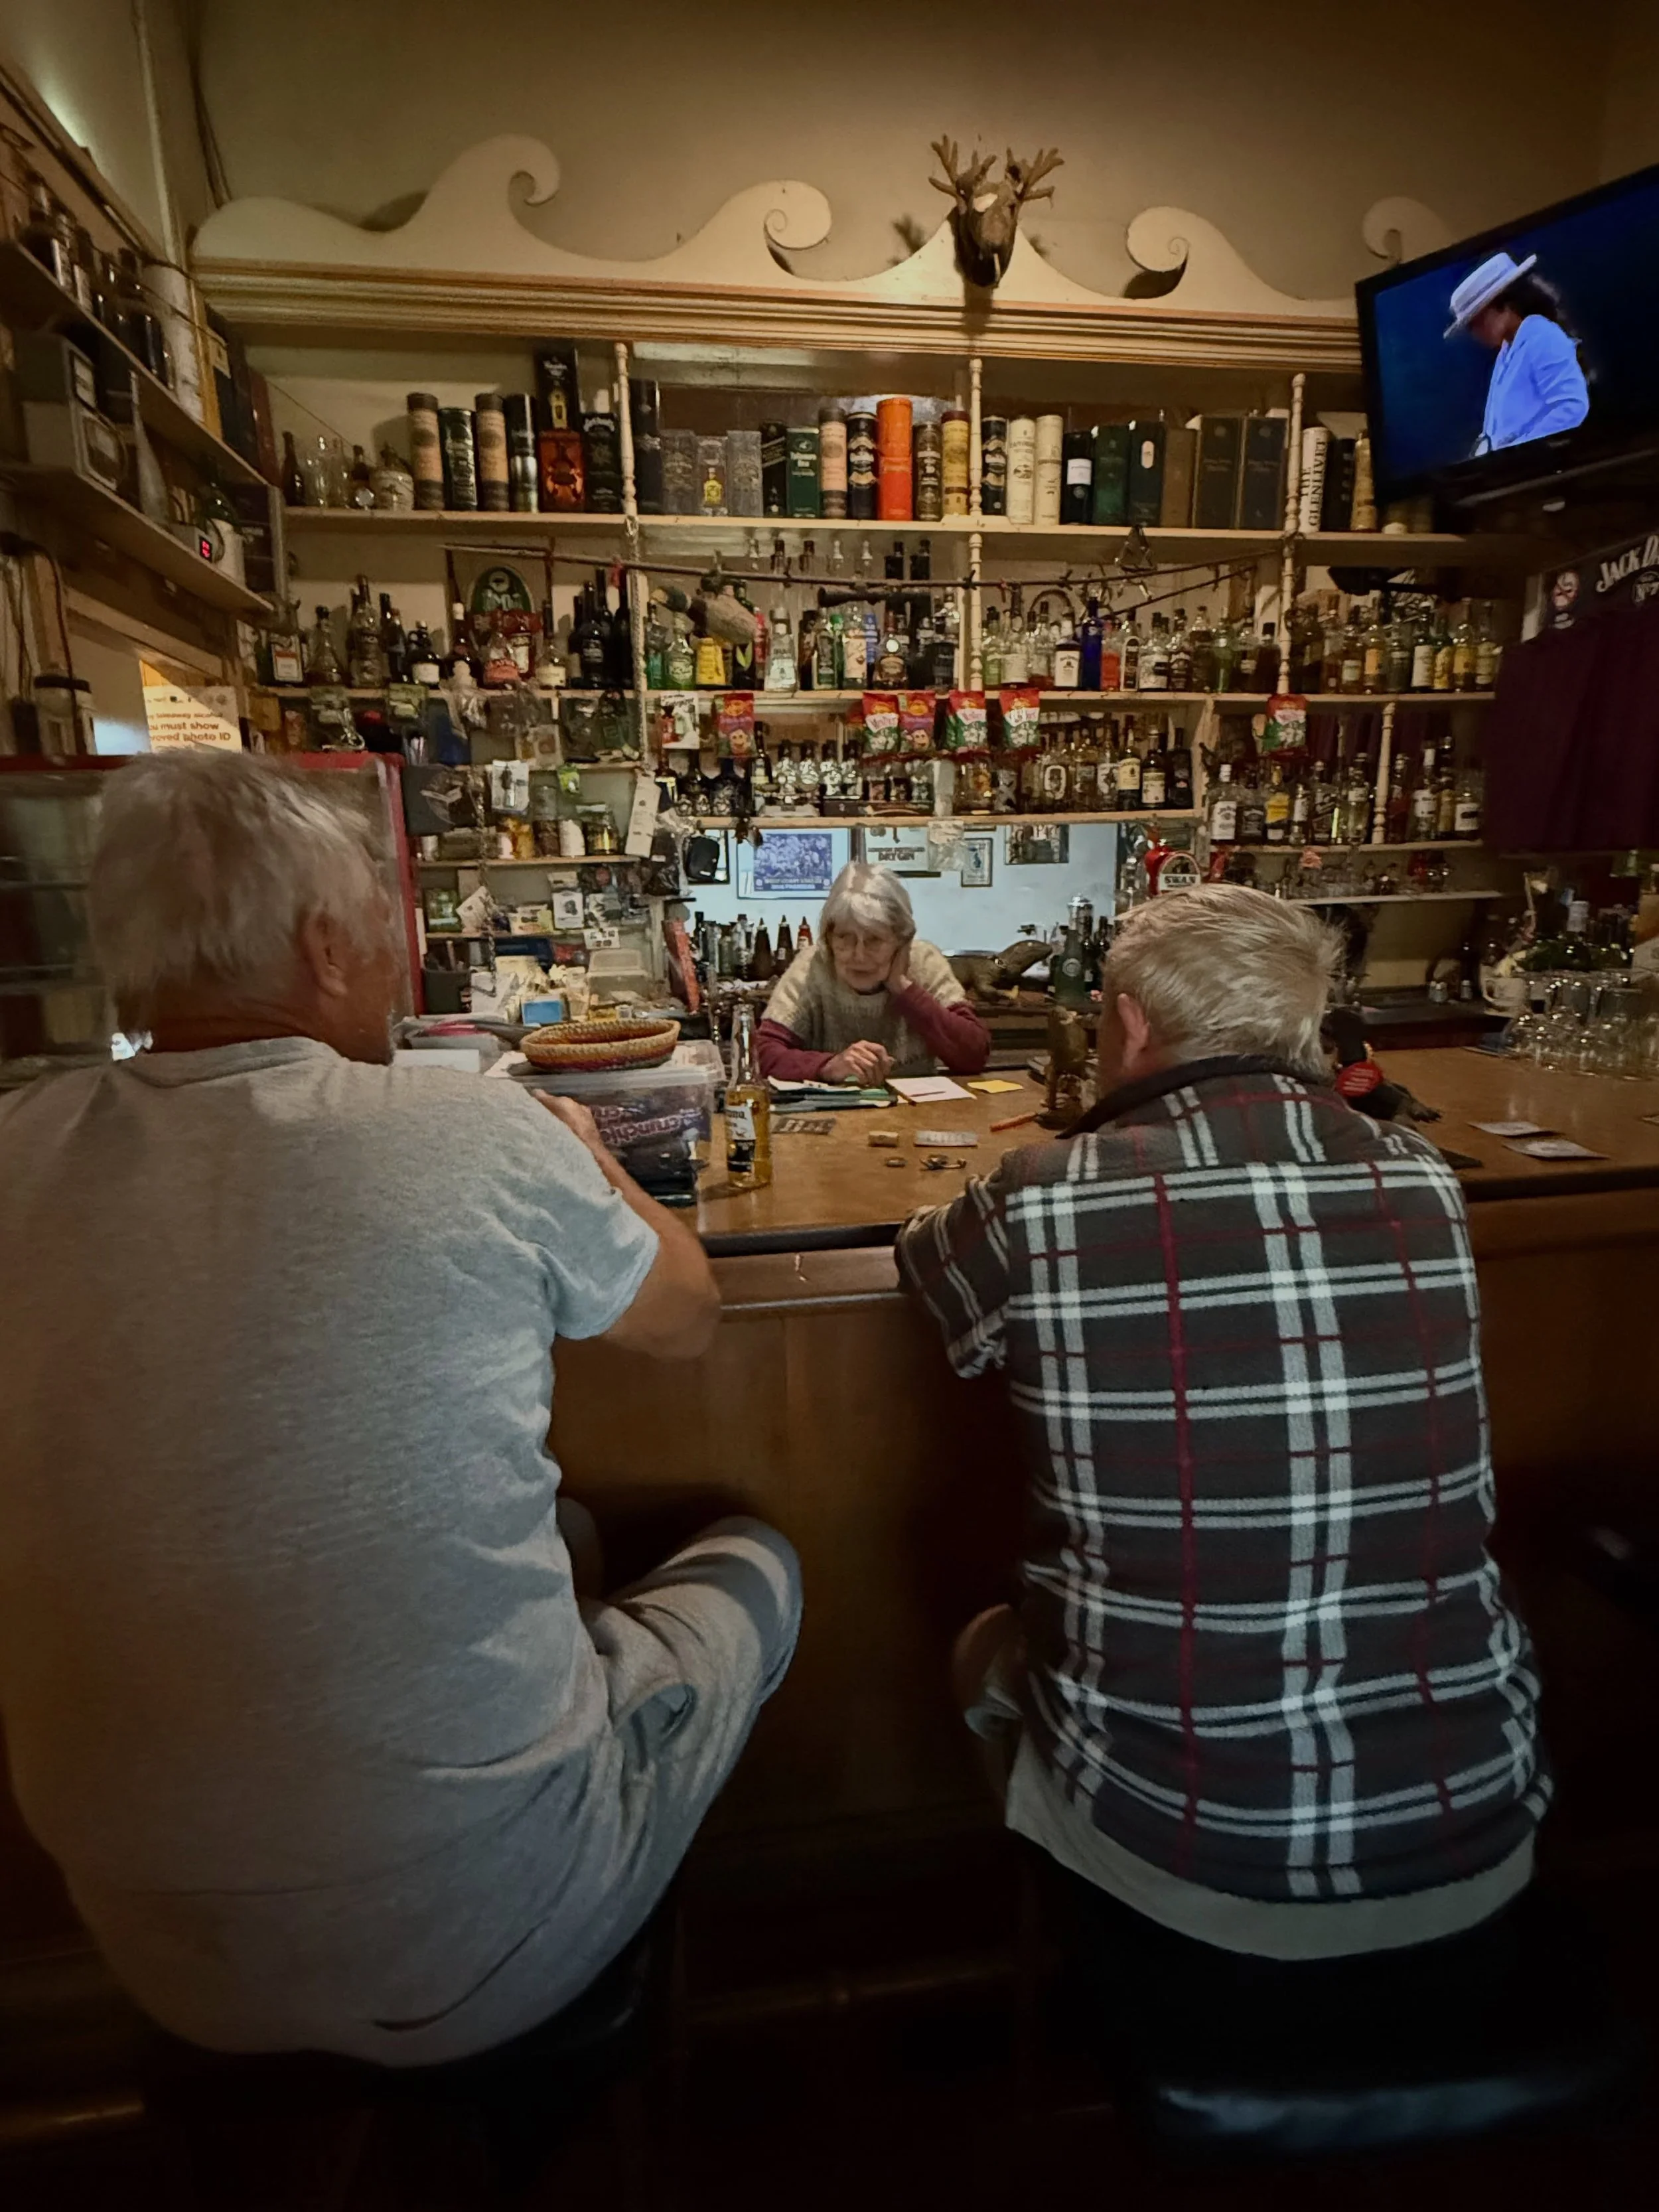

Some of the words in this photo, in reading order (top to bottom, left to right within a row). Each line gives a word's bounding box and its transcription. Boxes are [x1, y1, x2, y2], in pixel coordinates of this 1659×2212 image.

[1308, 438, 1327, 526] GLENLIVET
[1595, 548, 1640, 592] JACK
[182, 732, 216, 741] photo
[219, 732, 232, 741] ID
[190, 721, 220, 730] show
